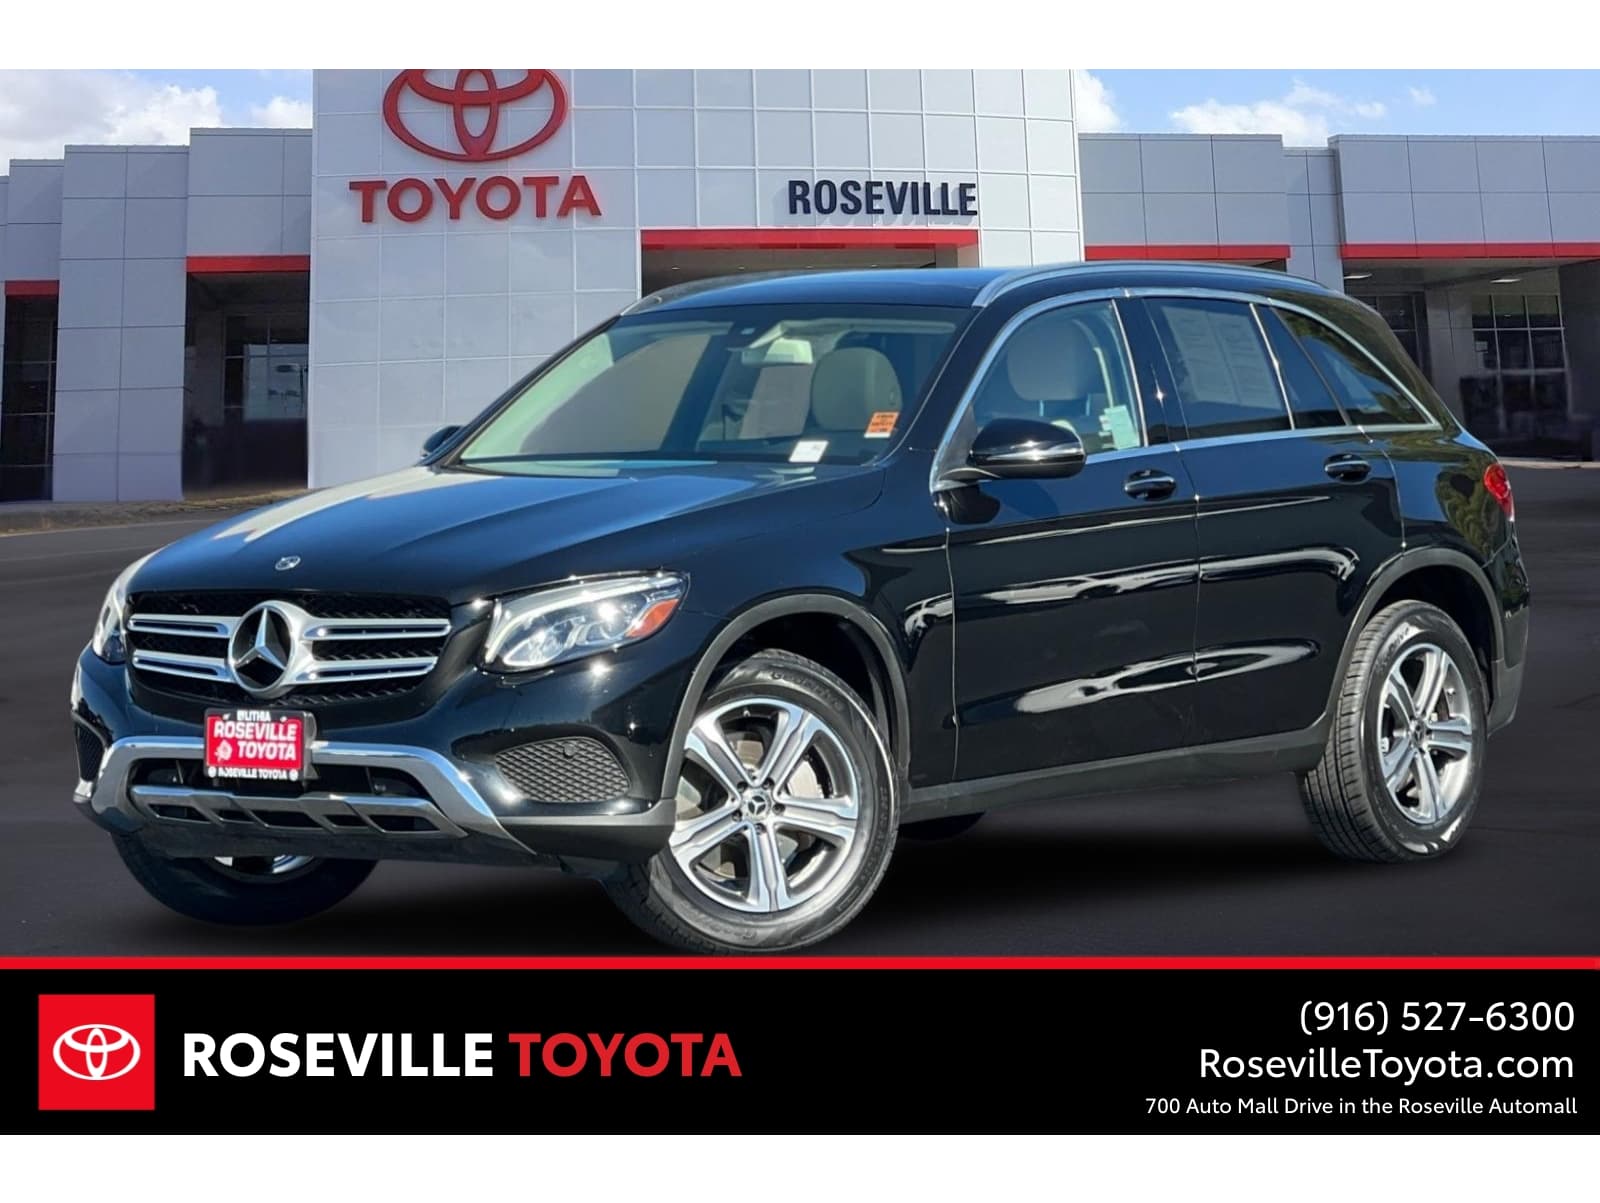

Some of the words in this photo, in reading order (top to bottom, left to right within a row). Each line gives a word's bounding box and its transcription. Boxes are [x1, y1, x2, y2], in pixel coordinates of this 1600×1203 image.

[349, 175, 602, 223] TOYOTA
[788, 180, 978, 216] ROSEVILLE
[213, 720, 298, 741] ROSEVILLE
[237, 741, 297, 761] TOYOTA
[218, 767, 258, 779] ROSEVILLE
[258, 769, 288, 780] TOYOTA
